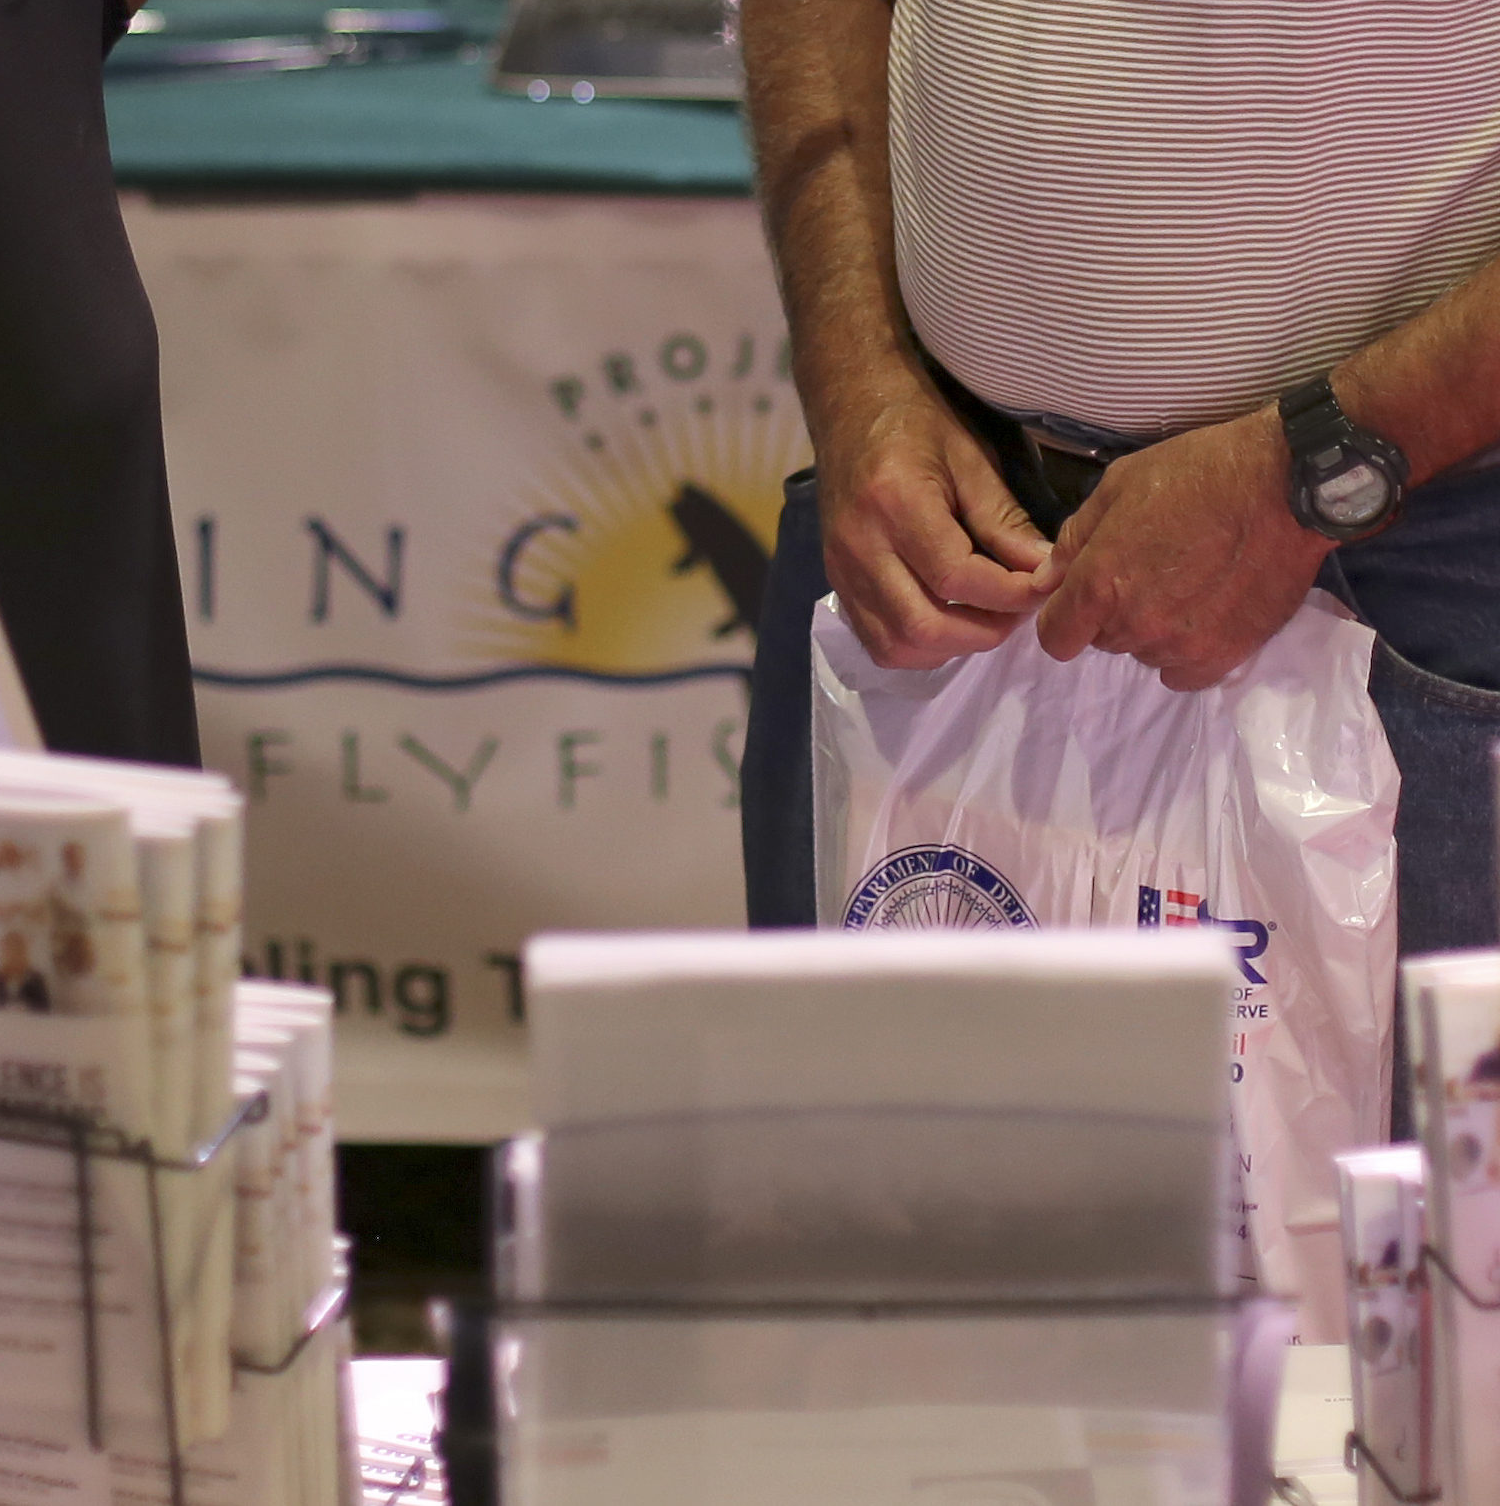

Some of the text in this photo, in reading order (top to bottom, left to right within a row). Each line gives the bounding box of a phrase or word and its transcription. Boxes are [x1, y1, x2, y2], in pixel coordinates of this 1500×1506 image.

[192, 510, 580, 634] ING
[554, 718, 742, 810] FIS
[843, 851, 1032, 934] EPARTMENT OF DEF
[239, 937, 453, 1038] ling
[1228, 1004, 1269, 1019] ERVE
